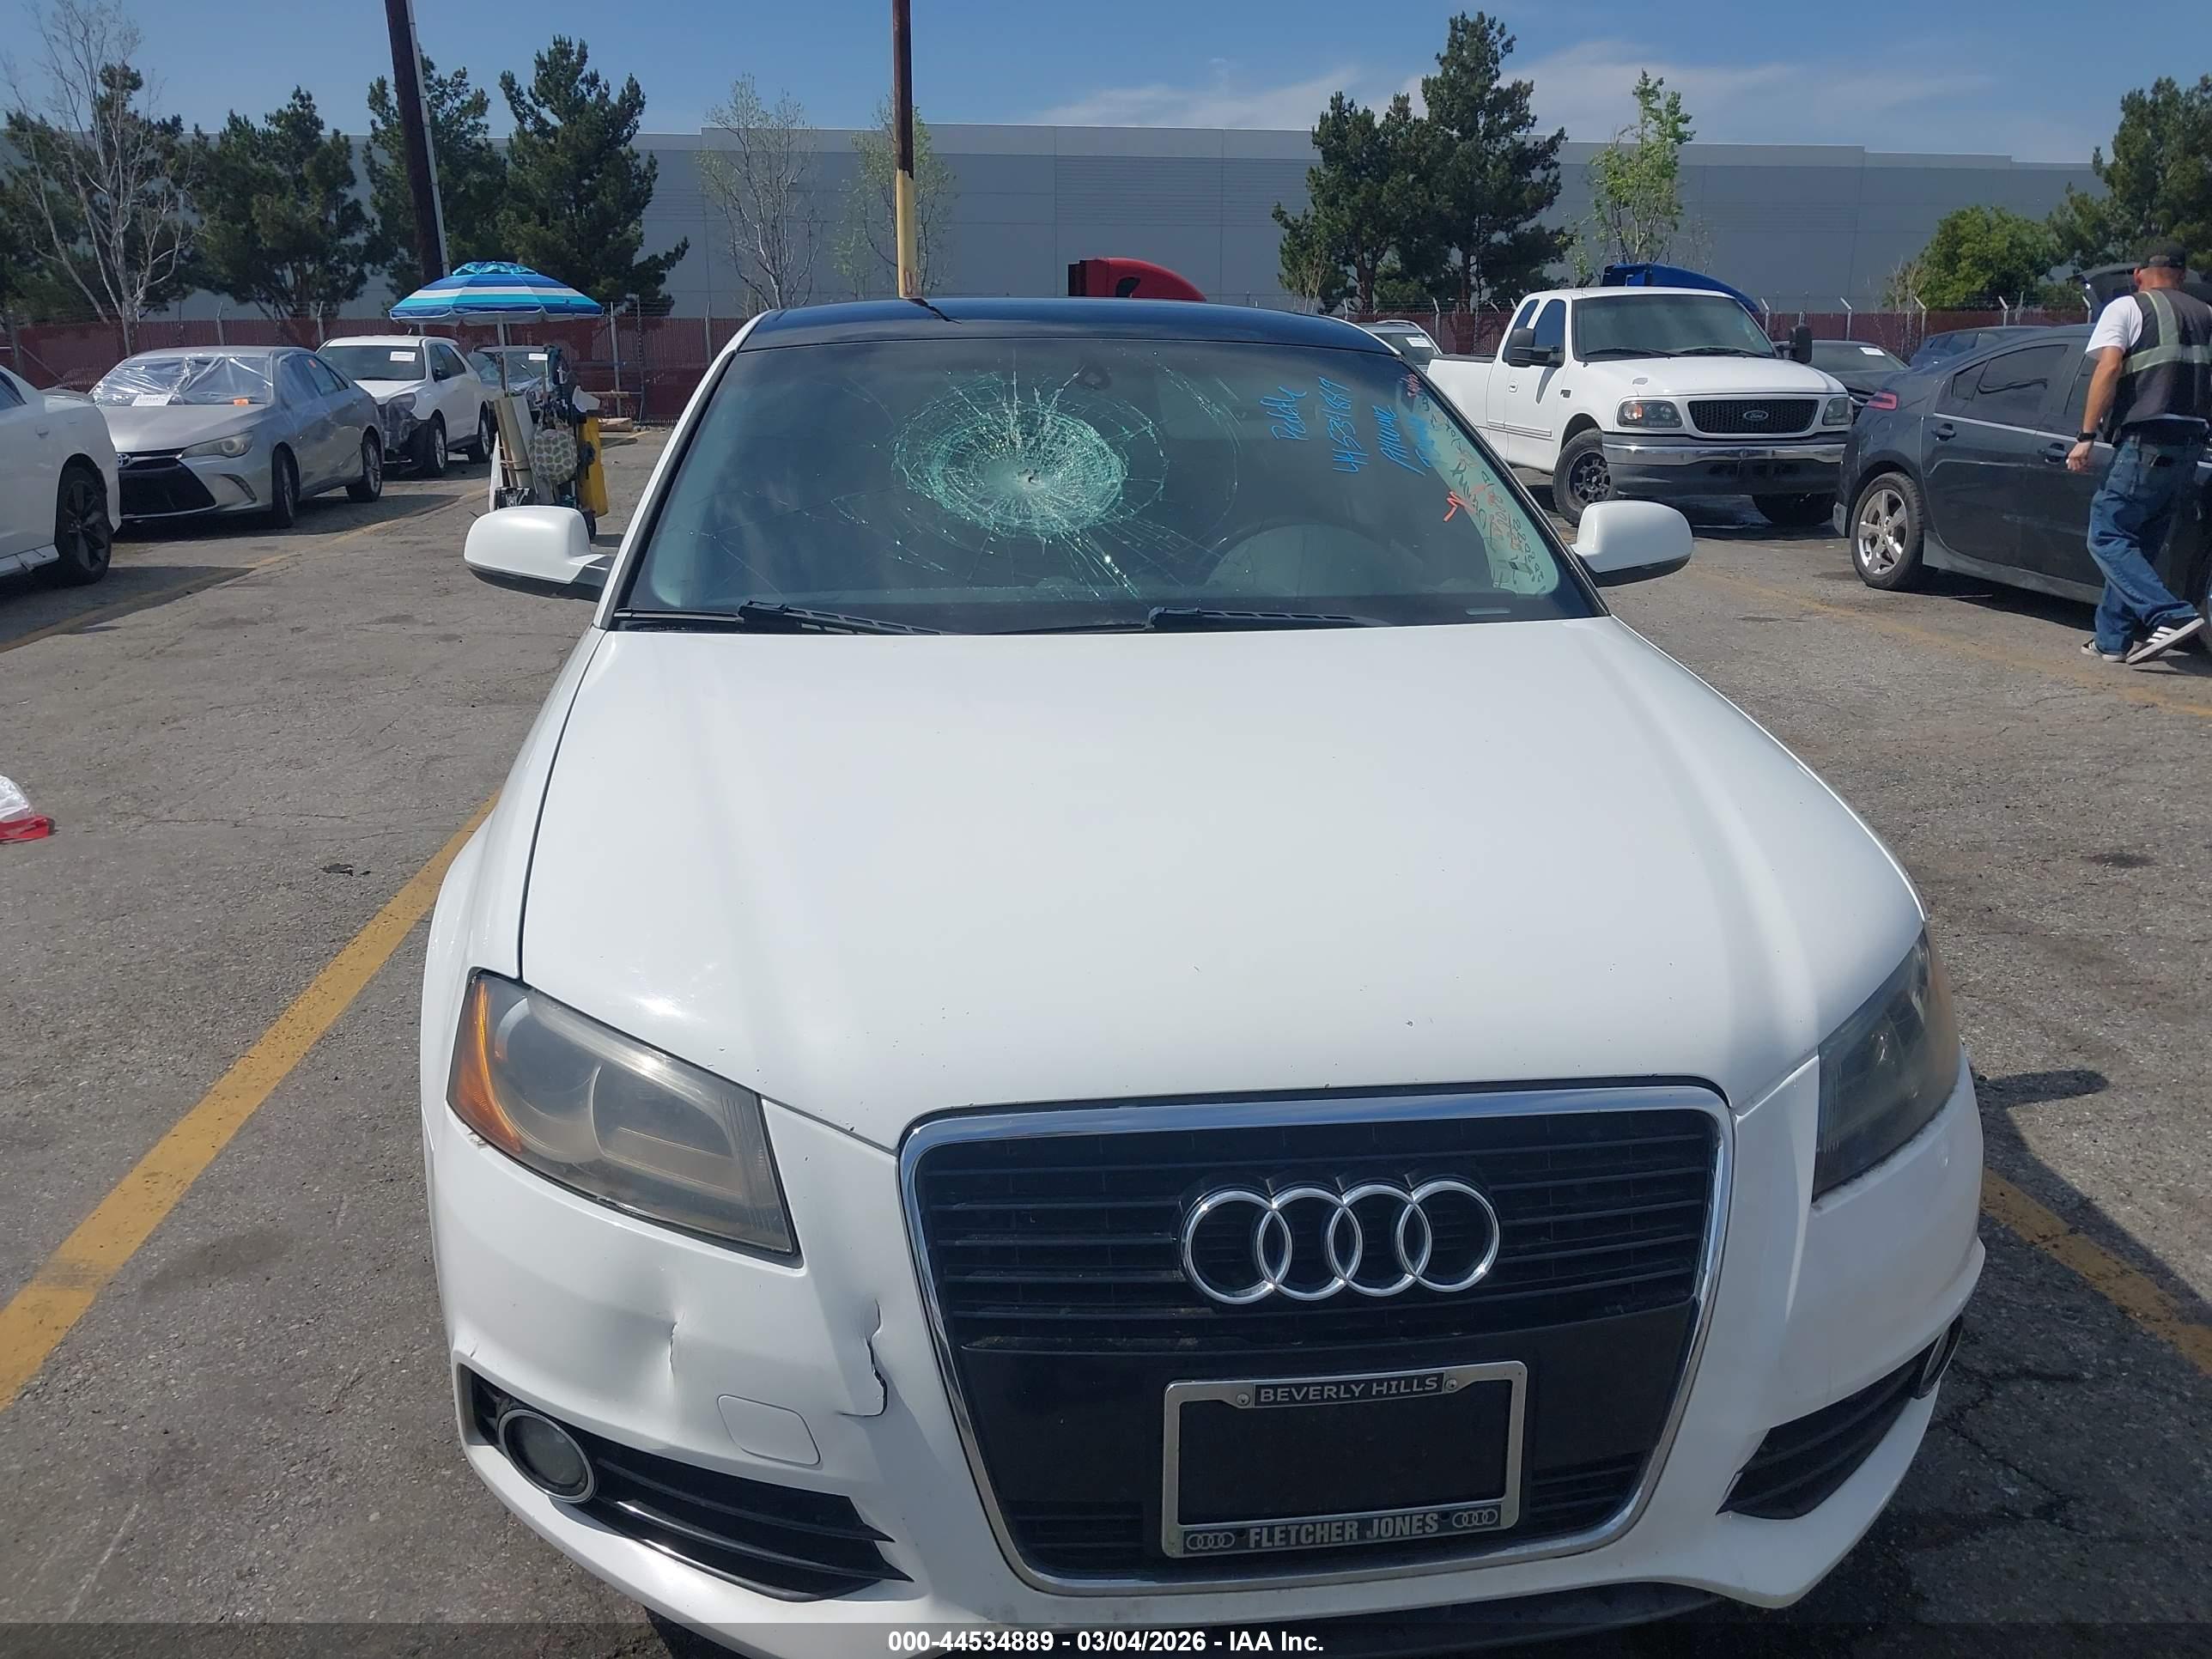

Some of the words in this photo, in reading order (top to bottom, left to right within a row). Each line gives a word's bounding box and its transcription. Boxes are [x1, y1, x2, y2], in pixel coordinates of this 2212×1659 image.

[1260, 1382, 1364, 1403] BEVERLY
[1371, 1376, 1438, 1396] HILLS
[1249, 1520, 1358, 1549] FLETCHER
[1366, 1512, 1440, 1539] JONES
